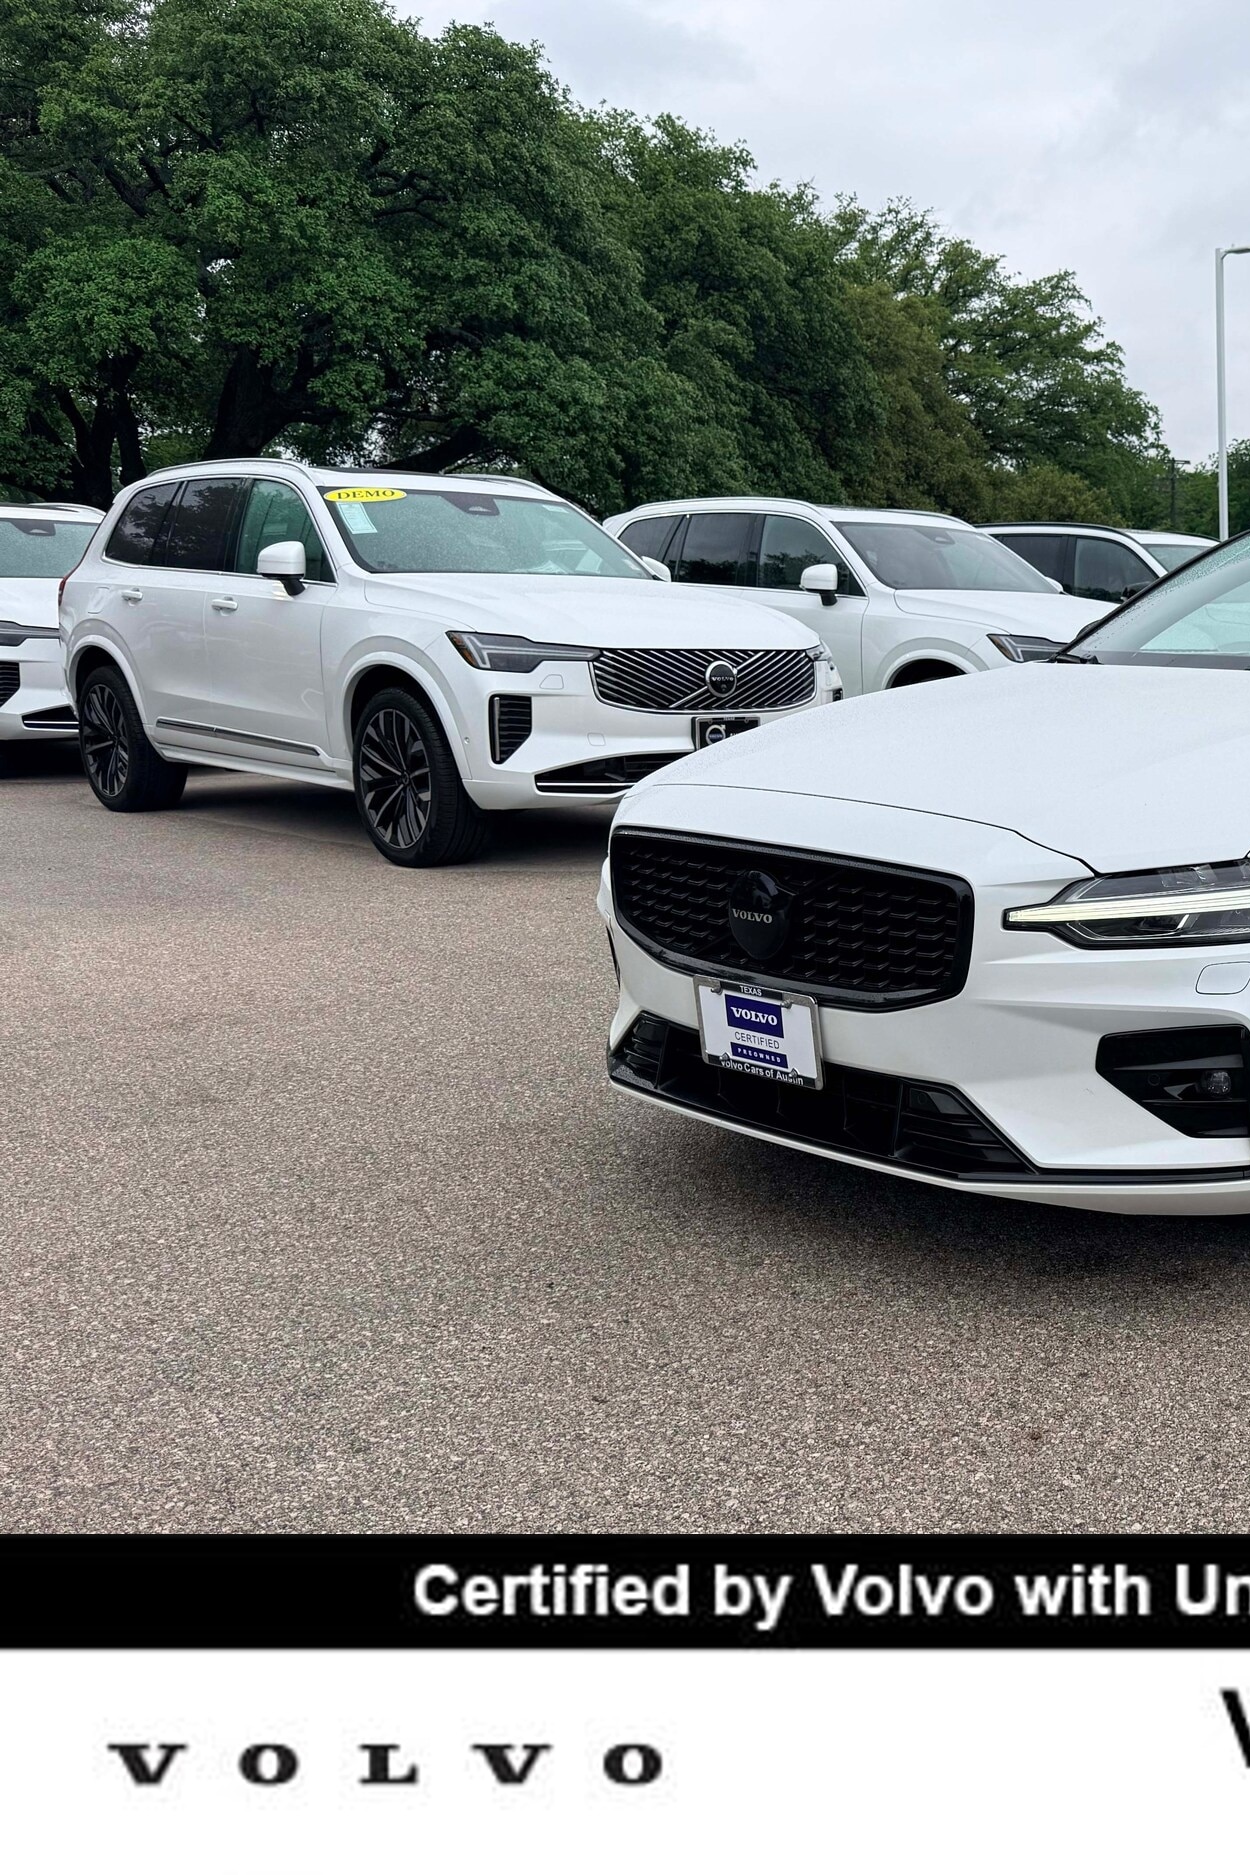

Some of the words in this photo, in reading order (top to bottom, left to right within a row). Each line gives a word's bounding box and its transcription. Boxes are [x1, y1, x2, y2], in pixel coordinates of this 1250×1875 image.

[337, 490, 395, 500] DEMO
[732, 908, 773, 924] VOLVO
[739, 985, 763, 997] TEXAS
[730, 1006, 778, 1026] VOLVO
[734, 1031, 780, 1050] CERTIFIED
[737, 1047, 781, 1063] PREOWNED
[744, 1064, 764, 1077] Cars
[765, 1069, 774, 1078] of
